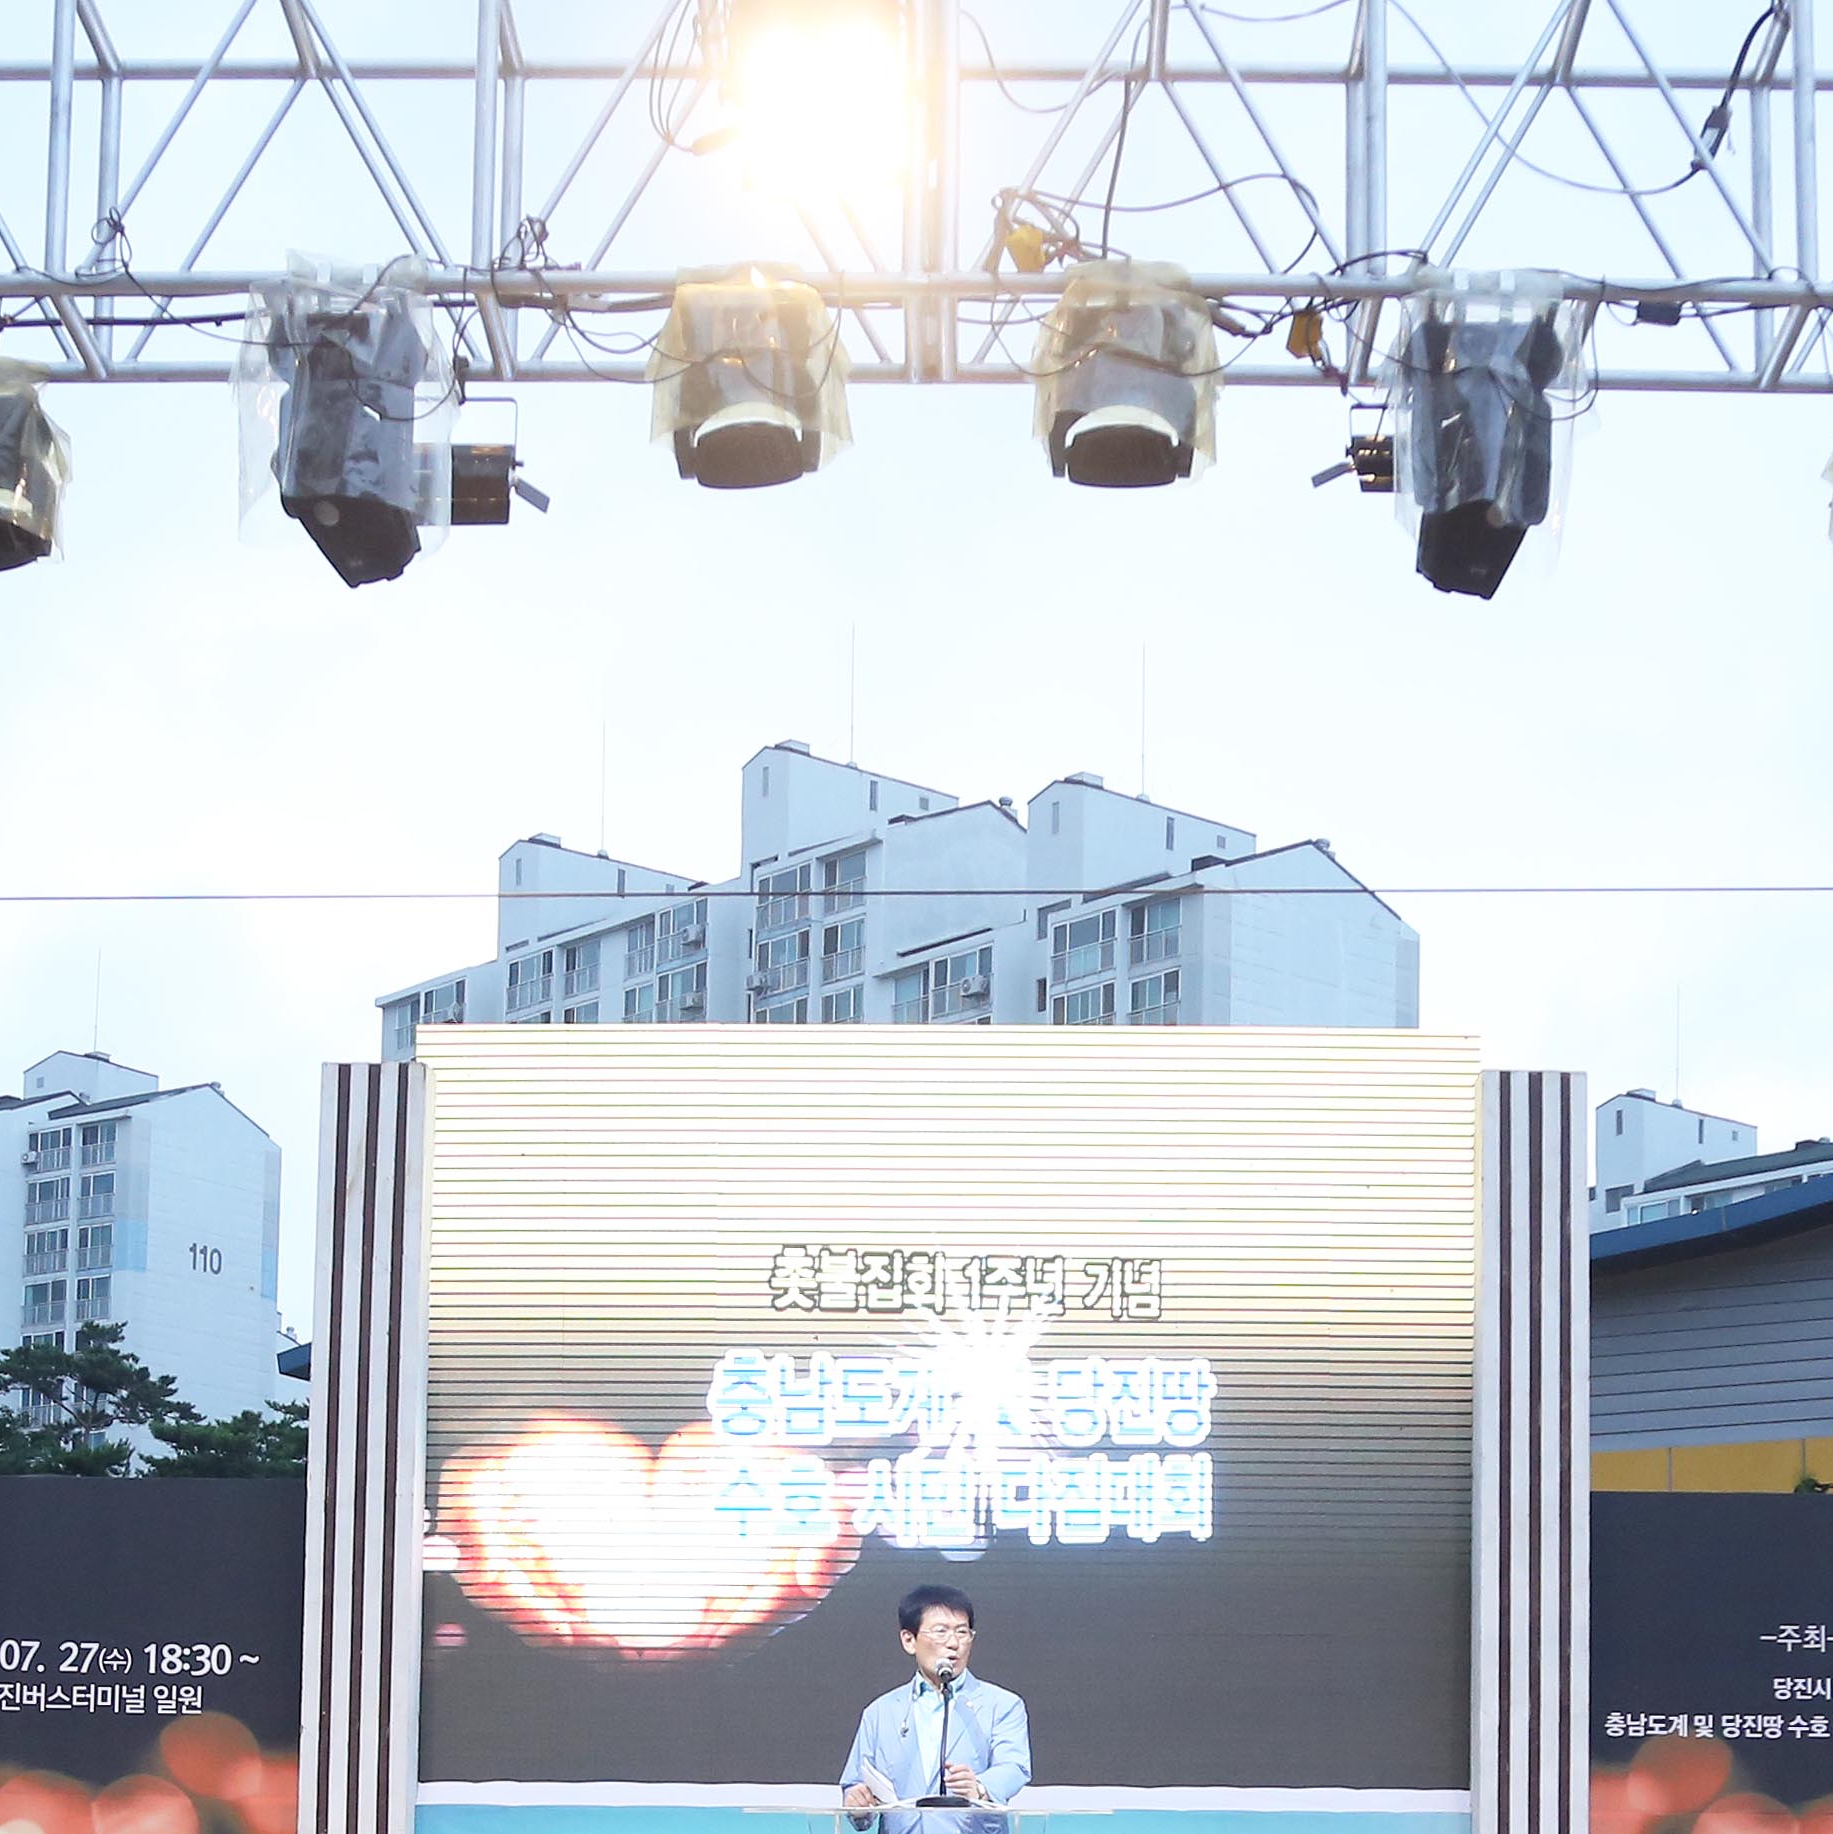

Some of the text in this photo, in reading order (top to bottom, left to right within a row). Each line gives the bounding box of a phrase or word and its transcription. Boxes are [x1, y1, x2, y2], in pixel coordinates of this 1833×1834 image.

[189, 1243, 222, 1275] 110
[769, 1244, 947, 1315] 촛불집회
[1080, 1257, 1163, 1320] 기념
[1048, 1357, 1214, 1445] 당진땅
[0, 1639, 45, 1673] 07.
[153, 1684, 203, 1715] 일원
[1772, 1677, 1832, 1700] 당진시
[1604, 1712, 1689, 1738] 충남도계
[1694, 1714, 1714, 1738] 및
[1721, 1714, 1784, 1738] 당진땅
[1787, 1715, 1831, 1738] 수호
